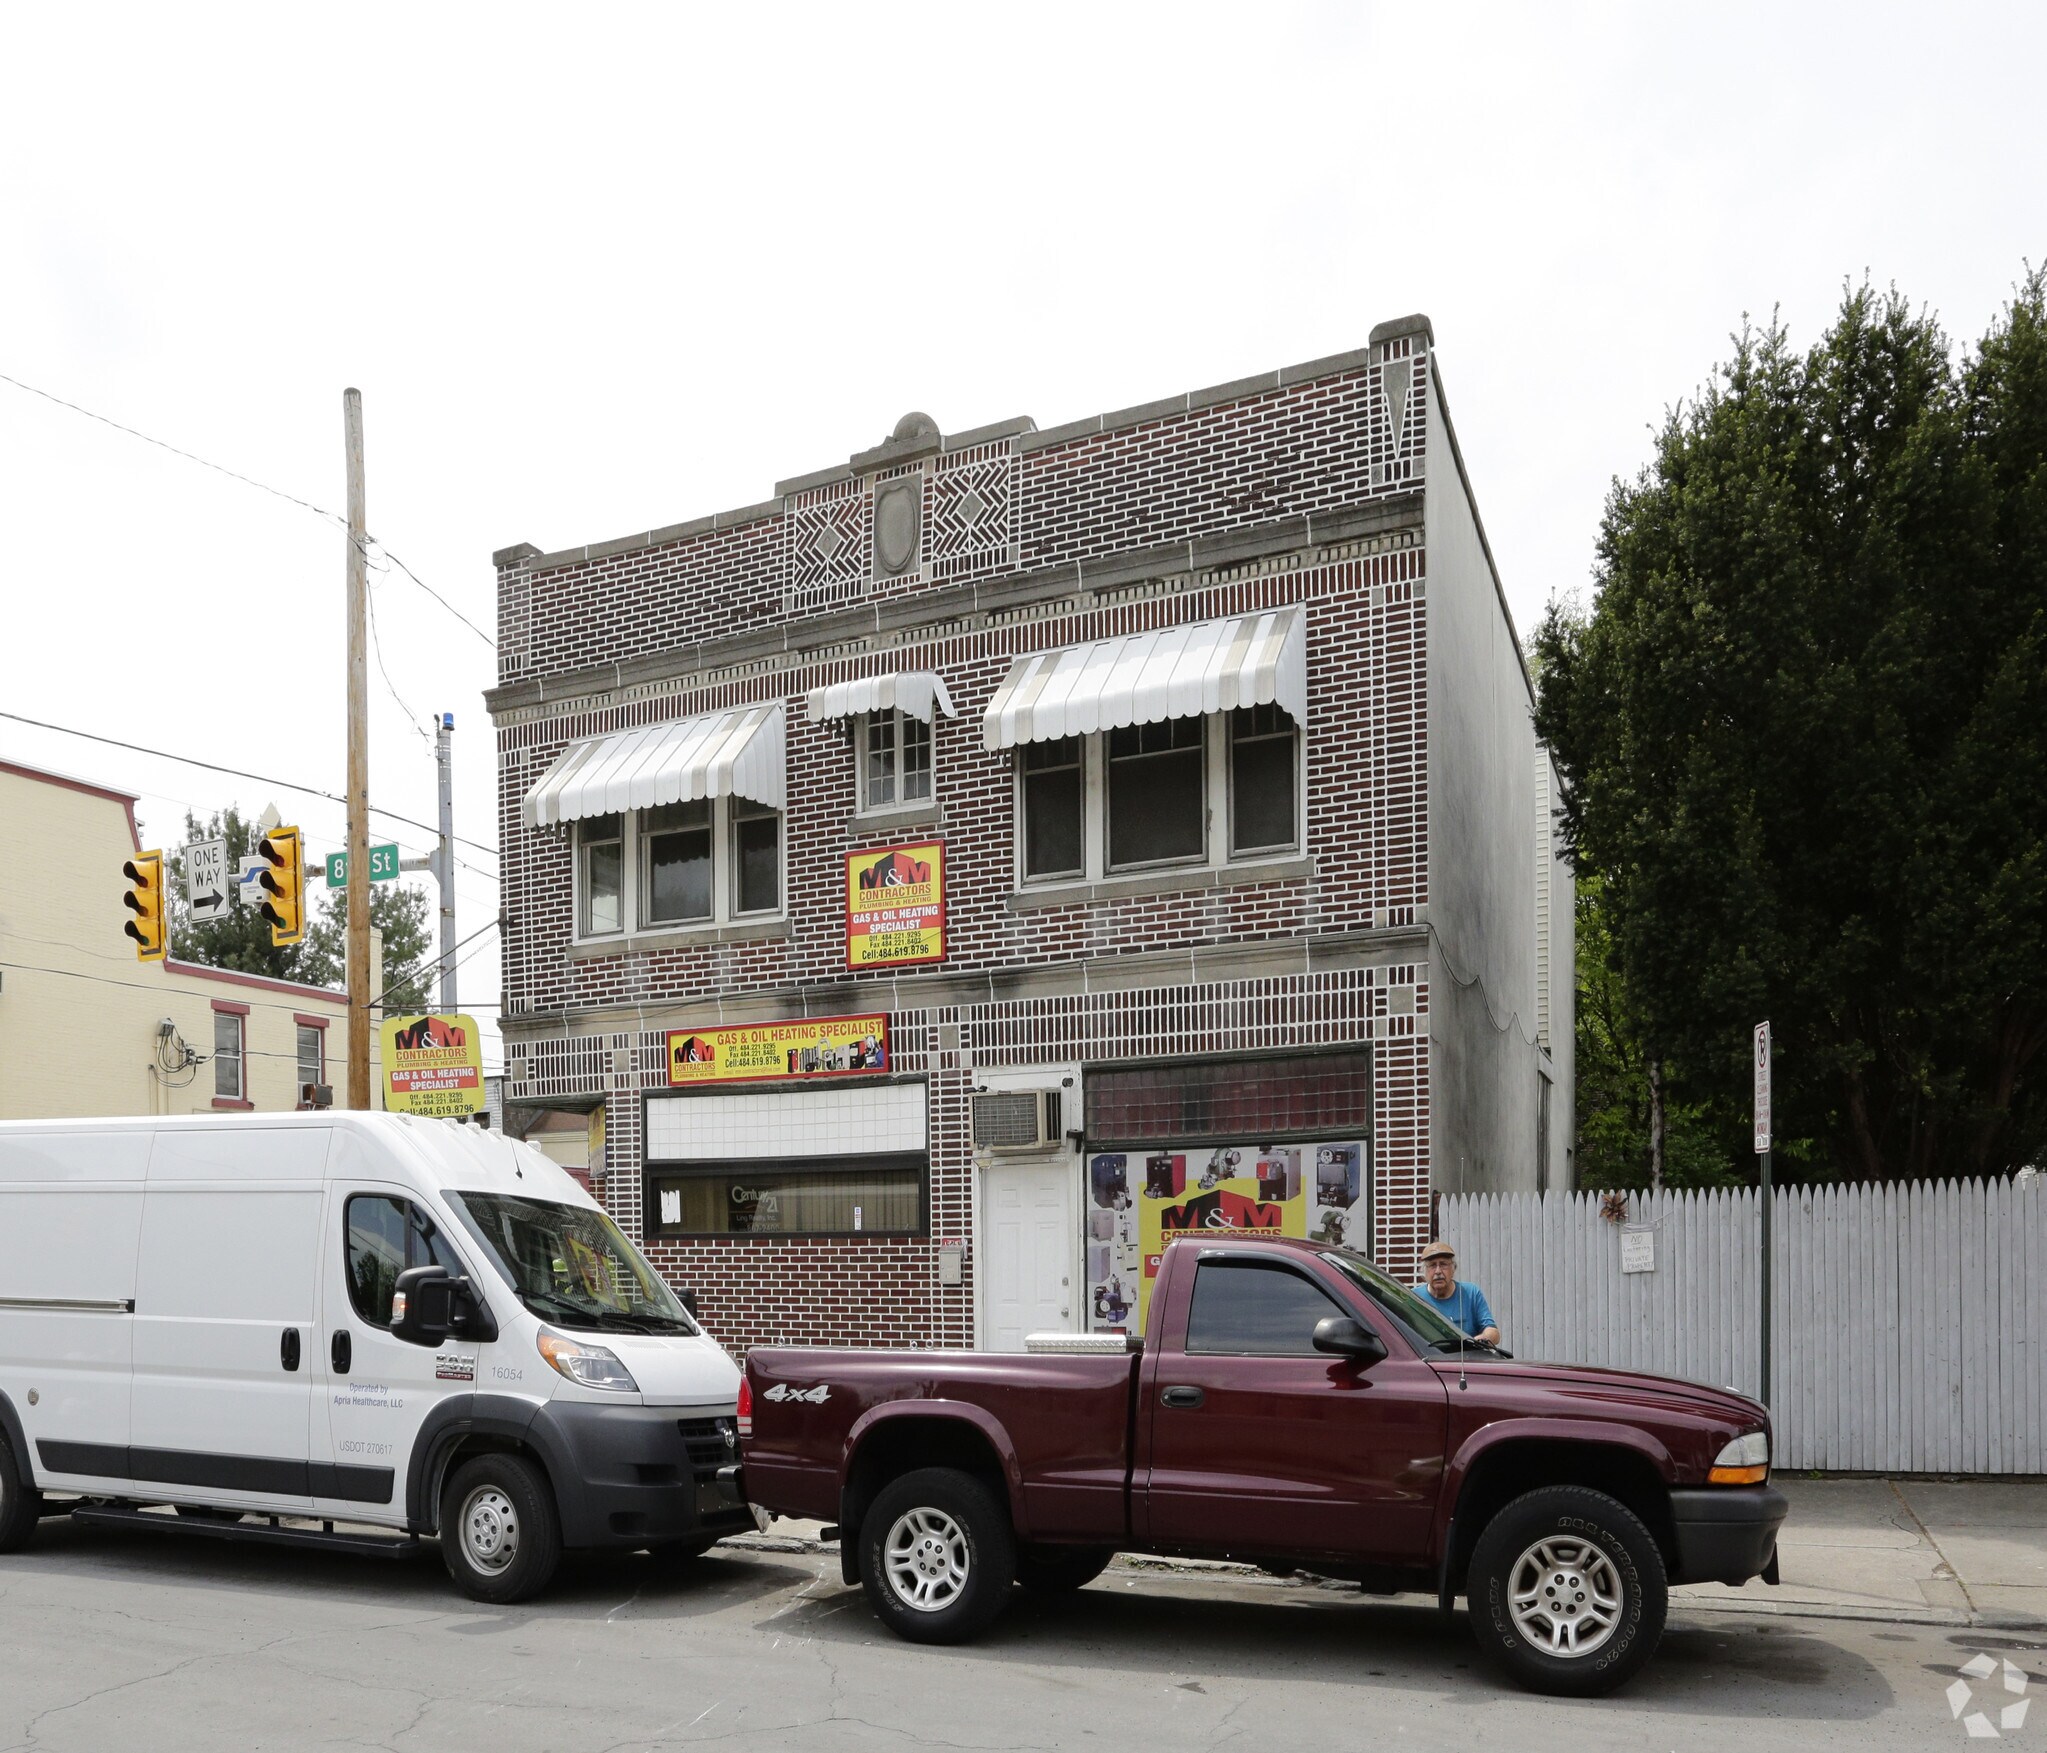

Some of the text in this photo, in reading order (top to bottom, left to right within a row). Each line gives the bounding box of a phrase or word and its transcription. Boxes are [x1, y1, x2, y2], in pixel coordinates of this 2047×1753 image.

[194, 847, 219, 866] ONE
[372, 852, 390, 872] St
[195, 868, 221, 888] WAY
[860, 852, 931, 890] M&M
[860, 884, 931, 901] CONTRACTORS
[860, 900, 894, 910] PLUMBING
[902, 896, 932, 905] HEATING
[853, 906, 938, 924] GAS & OIL HEATING
[870, 920, 920, 934] SPECIALIST
[882, 931, 922, 940] 484.221.9295
[862, 944, 929, 960] Cell:484.619.8796
[395, 1016, 466, 1050] M&M
[718, 1020, 882, 1046] GAS & OIL HEATING SPECIALIST
[396, 1048, 468, 1060] CONTRACTORS
[674, 1036, 716, 1063] M&M
[674, 1062, 716, 1072] CONTRACTORS
[725, 1056, 780, 1068] Cell:484.619.8796
[392, 1068, 474, 1081] GAS & OIL HEATING
[410, 1080, 460, 1090] SPECIALIST
[732, 1186, 768, 1203] Century
[766, 1196, 778, 1212] 21
[1162, 1190, 1282, 1229] M&M
[436, 1354, 474, 1364] RAM
[492, 1367, 522, 1380] 16054
[350, 1383, 388, 1394] Operated by
[763, 1384, 832, 1404] 4x4
[334, 1396, 404, 1408] Apria Healthcare, LLC
[340, 1440, 392, 1456] USDOT 270617
